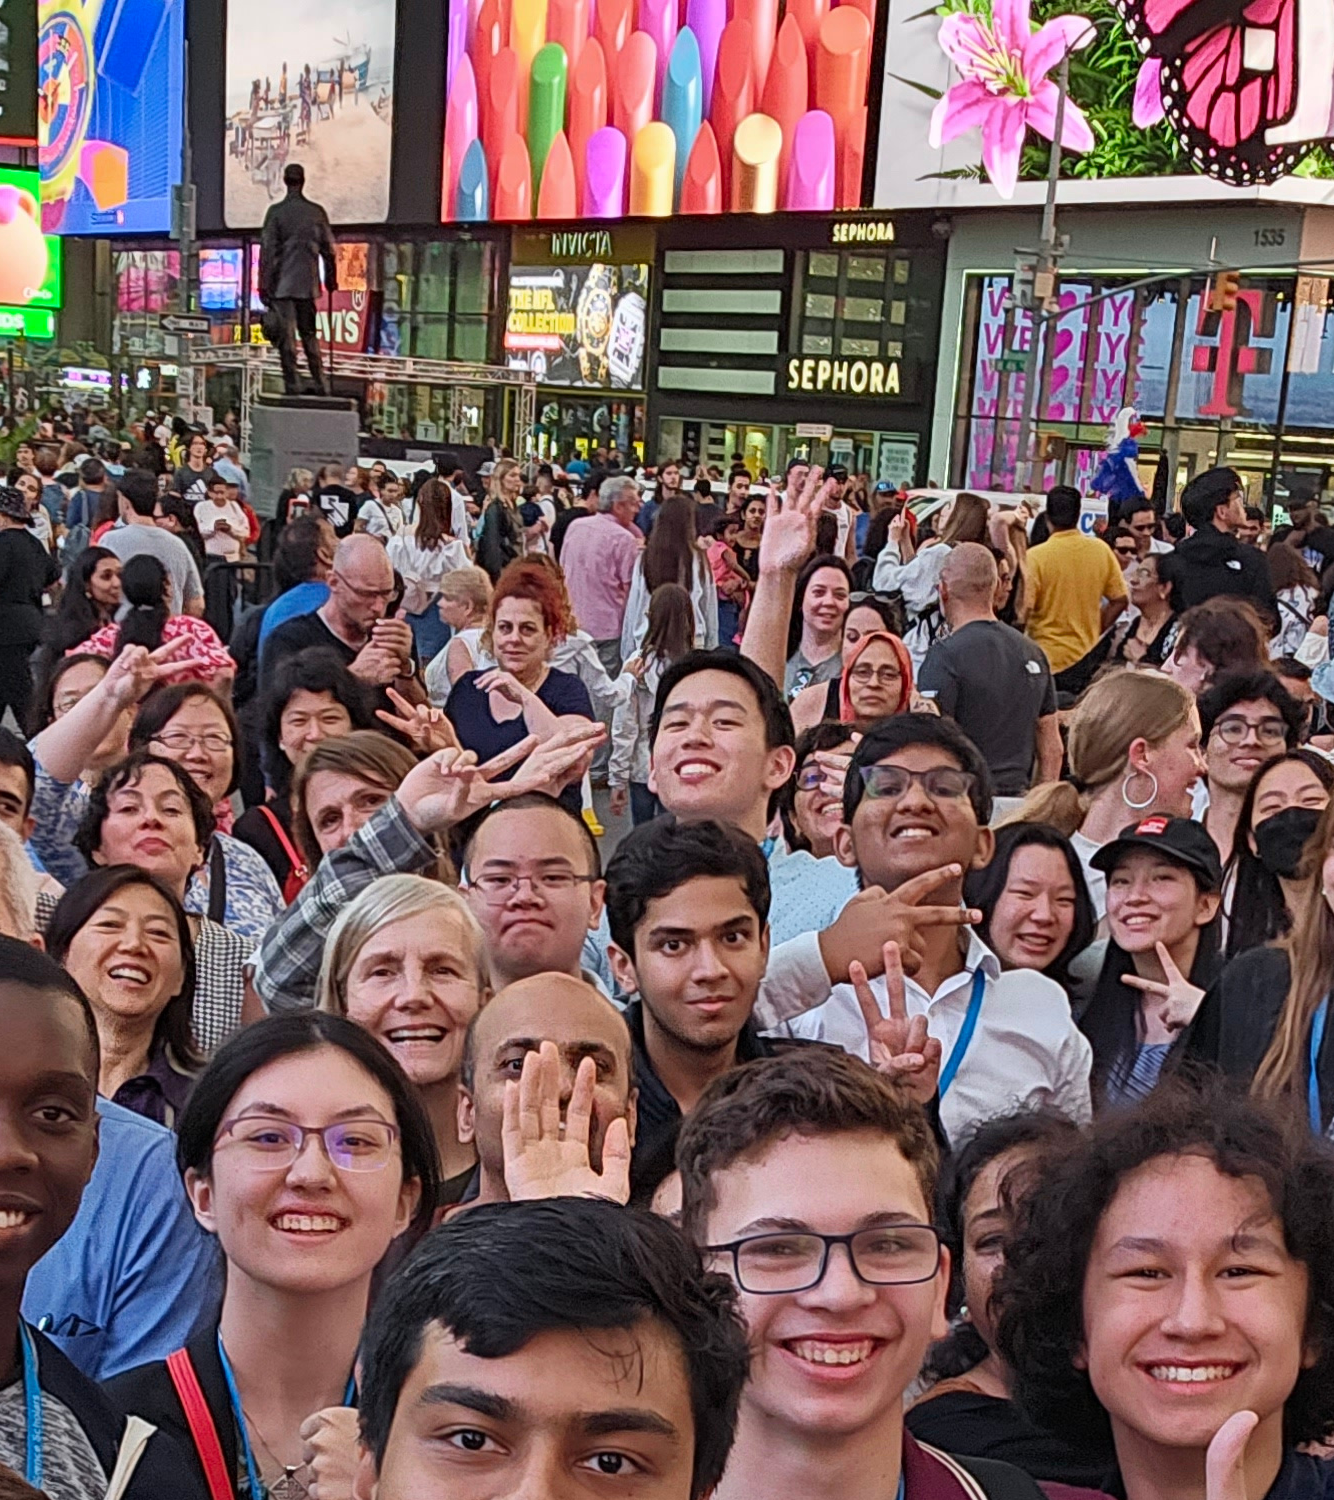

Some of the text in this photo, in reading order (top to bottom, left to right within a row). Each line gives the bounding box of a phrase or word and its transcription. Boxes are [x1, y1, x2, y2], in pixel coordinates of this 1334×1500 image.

[832, 222, 895, 242] SEPHORA
[1253, 229, 1285, 247] 1535
[551, 230, 613, 257] INVICTA
[509, 312, 575, 333] COLLECTION
[788, 359, 900, 394] SEPHORA
